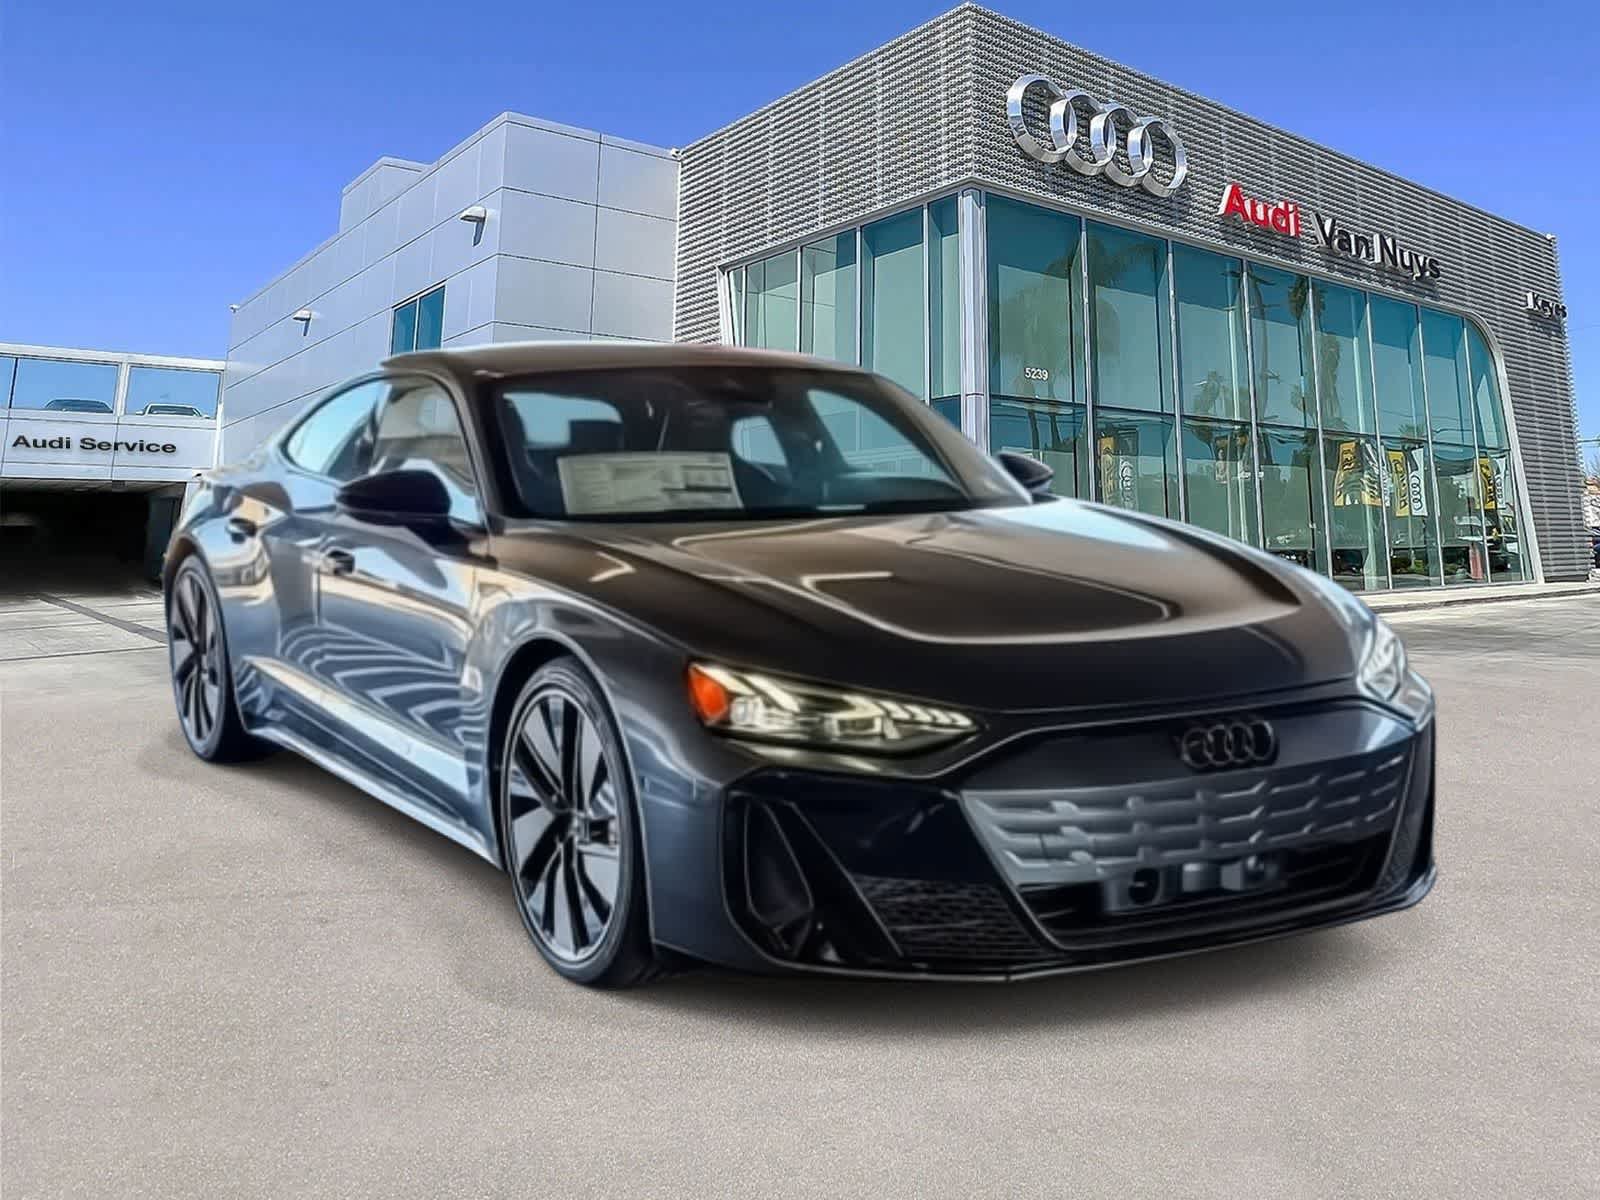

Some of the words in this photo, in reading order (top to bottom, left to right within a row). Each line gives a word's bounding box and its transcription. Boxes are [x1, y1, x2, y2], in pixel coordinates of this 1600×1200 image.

[1218, 183, 1301, 237] Audi
[1311, 211, 1371, 261] Van
[1372, 232, 1441, 280] Nuys
[1025, 367, 1049, 381] 5239
[12, 435, 71, 449] Audi
[79, 437, 177, 454] Service
